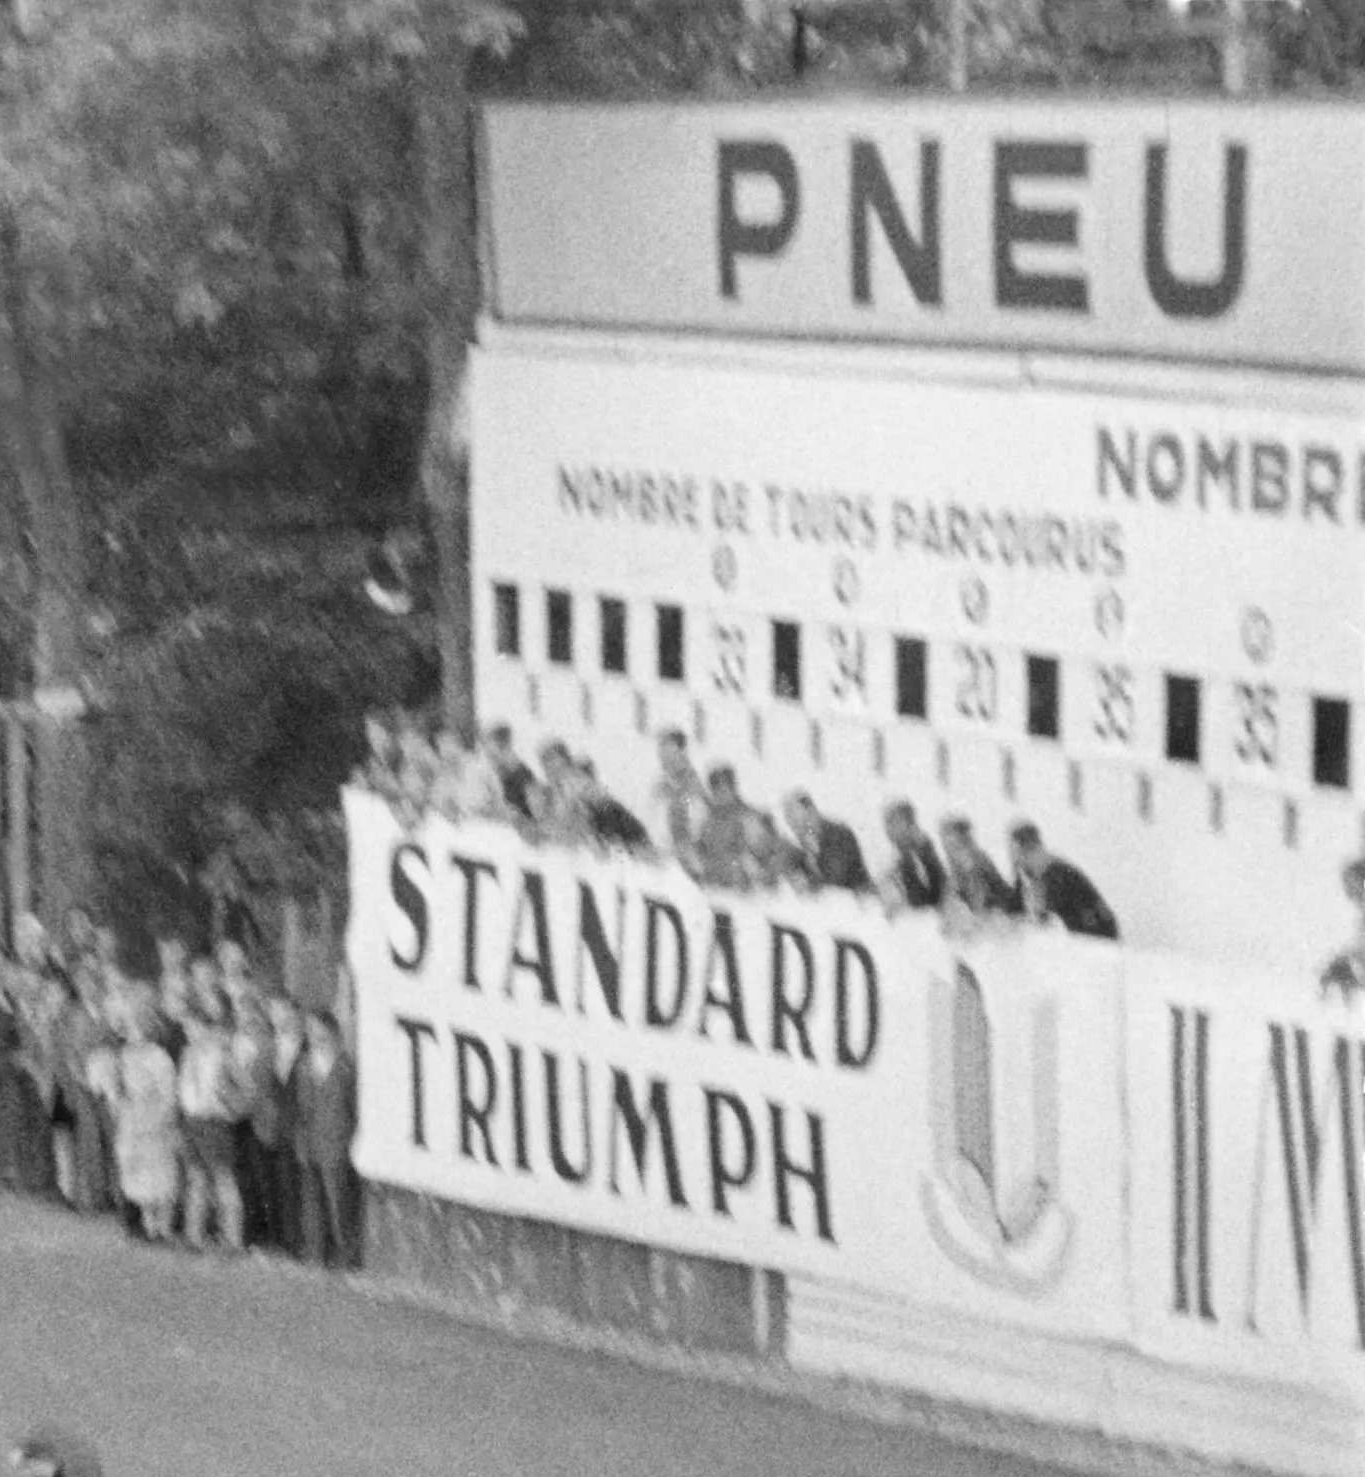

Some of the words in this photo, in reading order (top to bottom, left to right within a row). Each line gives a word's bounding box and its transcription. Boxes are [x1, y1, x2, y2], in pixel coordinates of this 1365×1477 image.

[715, 138, 1249, 319] PNEU
[558, 466, 699, 530] NOMBRE
[712, 480, 750, 535] DE
[765, 484, 877, 549] TOURS
[891, 498, 1127, 578] PARCOURUS
[1097, 424, 1363, 528] NOMBR
[388, 840, 883, 1072] STANDARD
[395, 1014, 838, 1245] TRIUMPH
